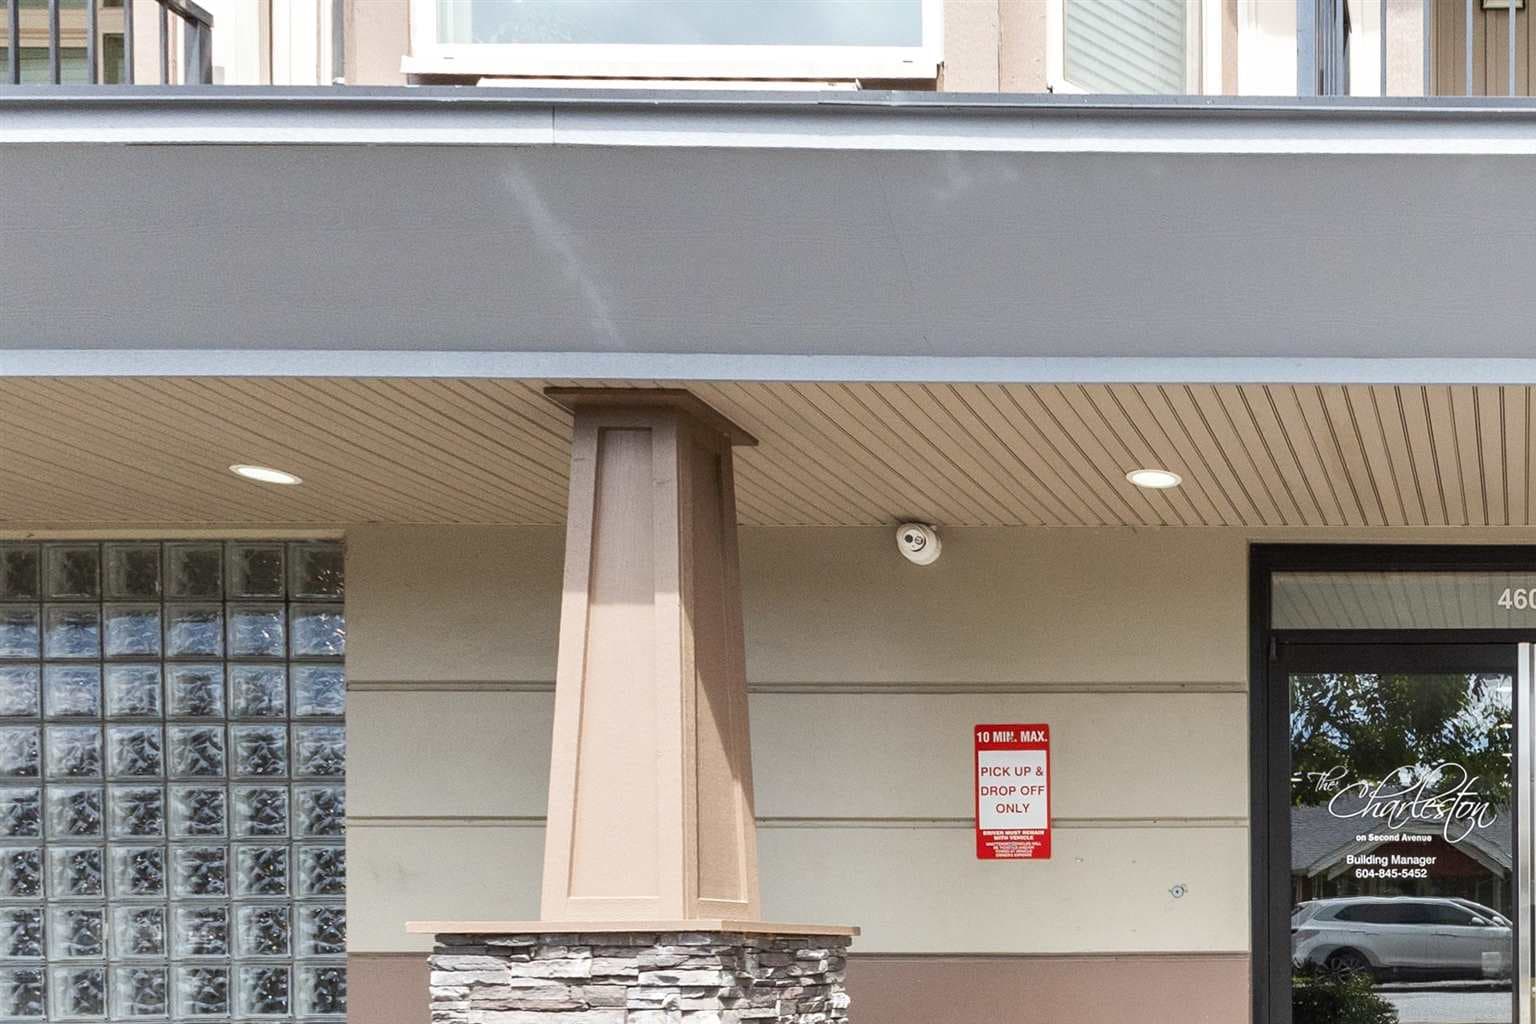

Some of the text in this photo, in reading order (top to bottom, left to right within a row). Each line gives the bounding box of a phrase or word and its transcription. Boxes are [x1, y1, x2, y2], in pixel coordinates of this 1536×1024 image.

[977, 730, 1048, 743] 10 MIN. MAX.
[981, 766, 1044, 777] PICK UP &
[981, 785, 1045, 797] DROP OFF
[995, 803, 1030, 814] ONLY
[1307, 762, 1497, 844] The Charleston
[1355, 833, 1432, 842] on Second Avenue
[1346, 854, 1437, 867] Building Manager
[1355, 868, 1428, 879] 604-845-5452
